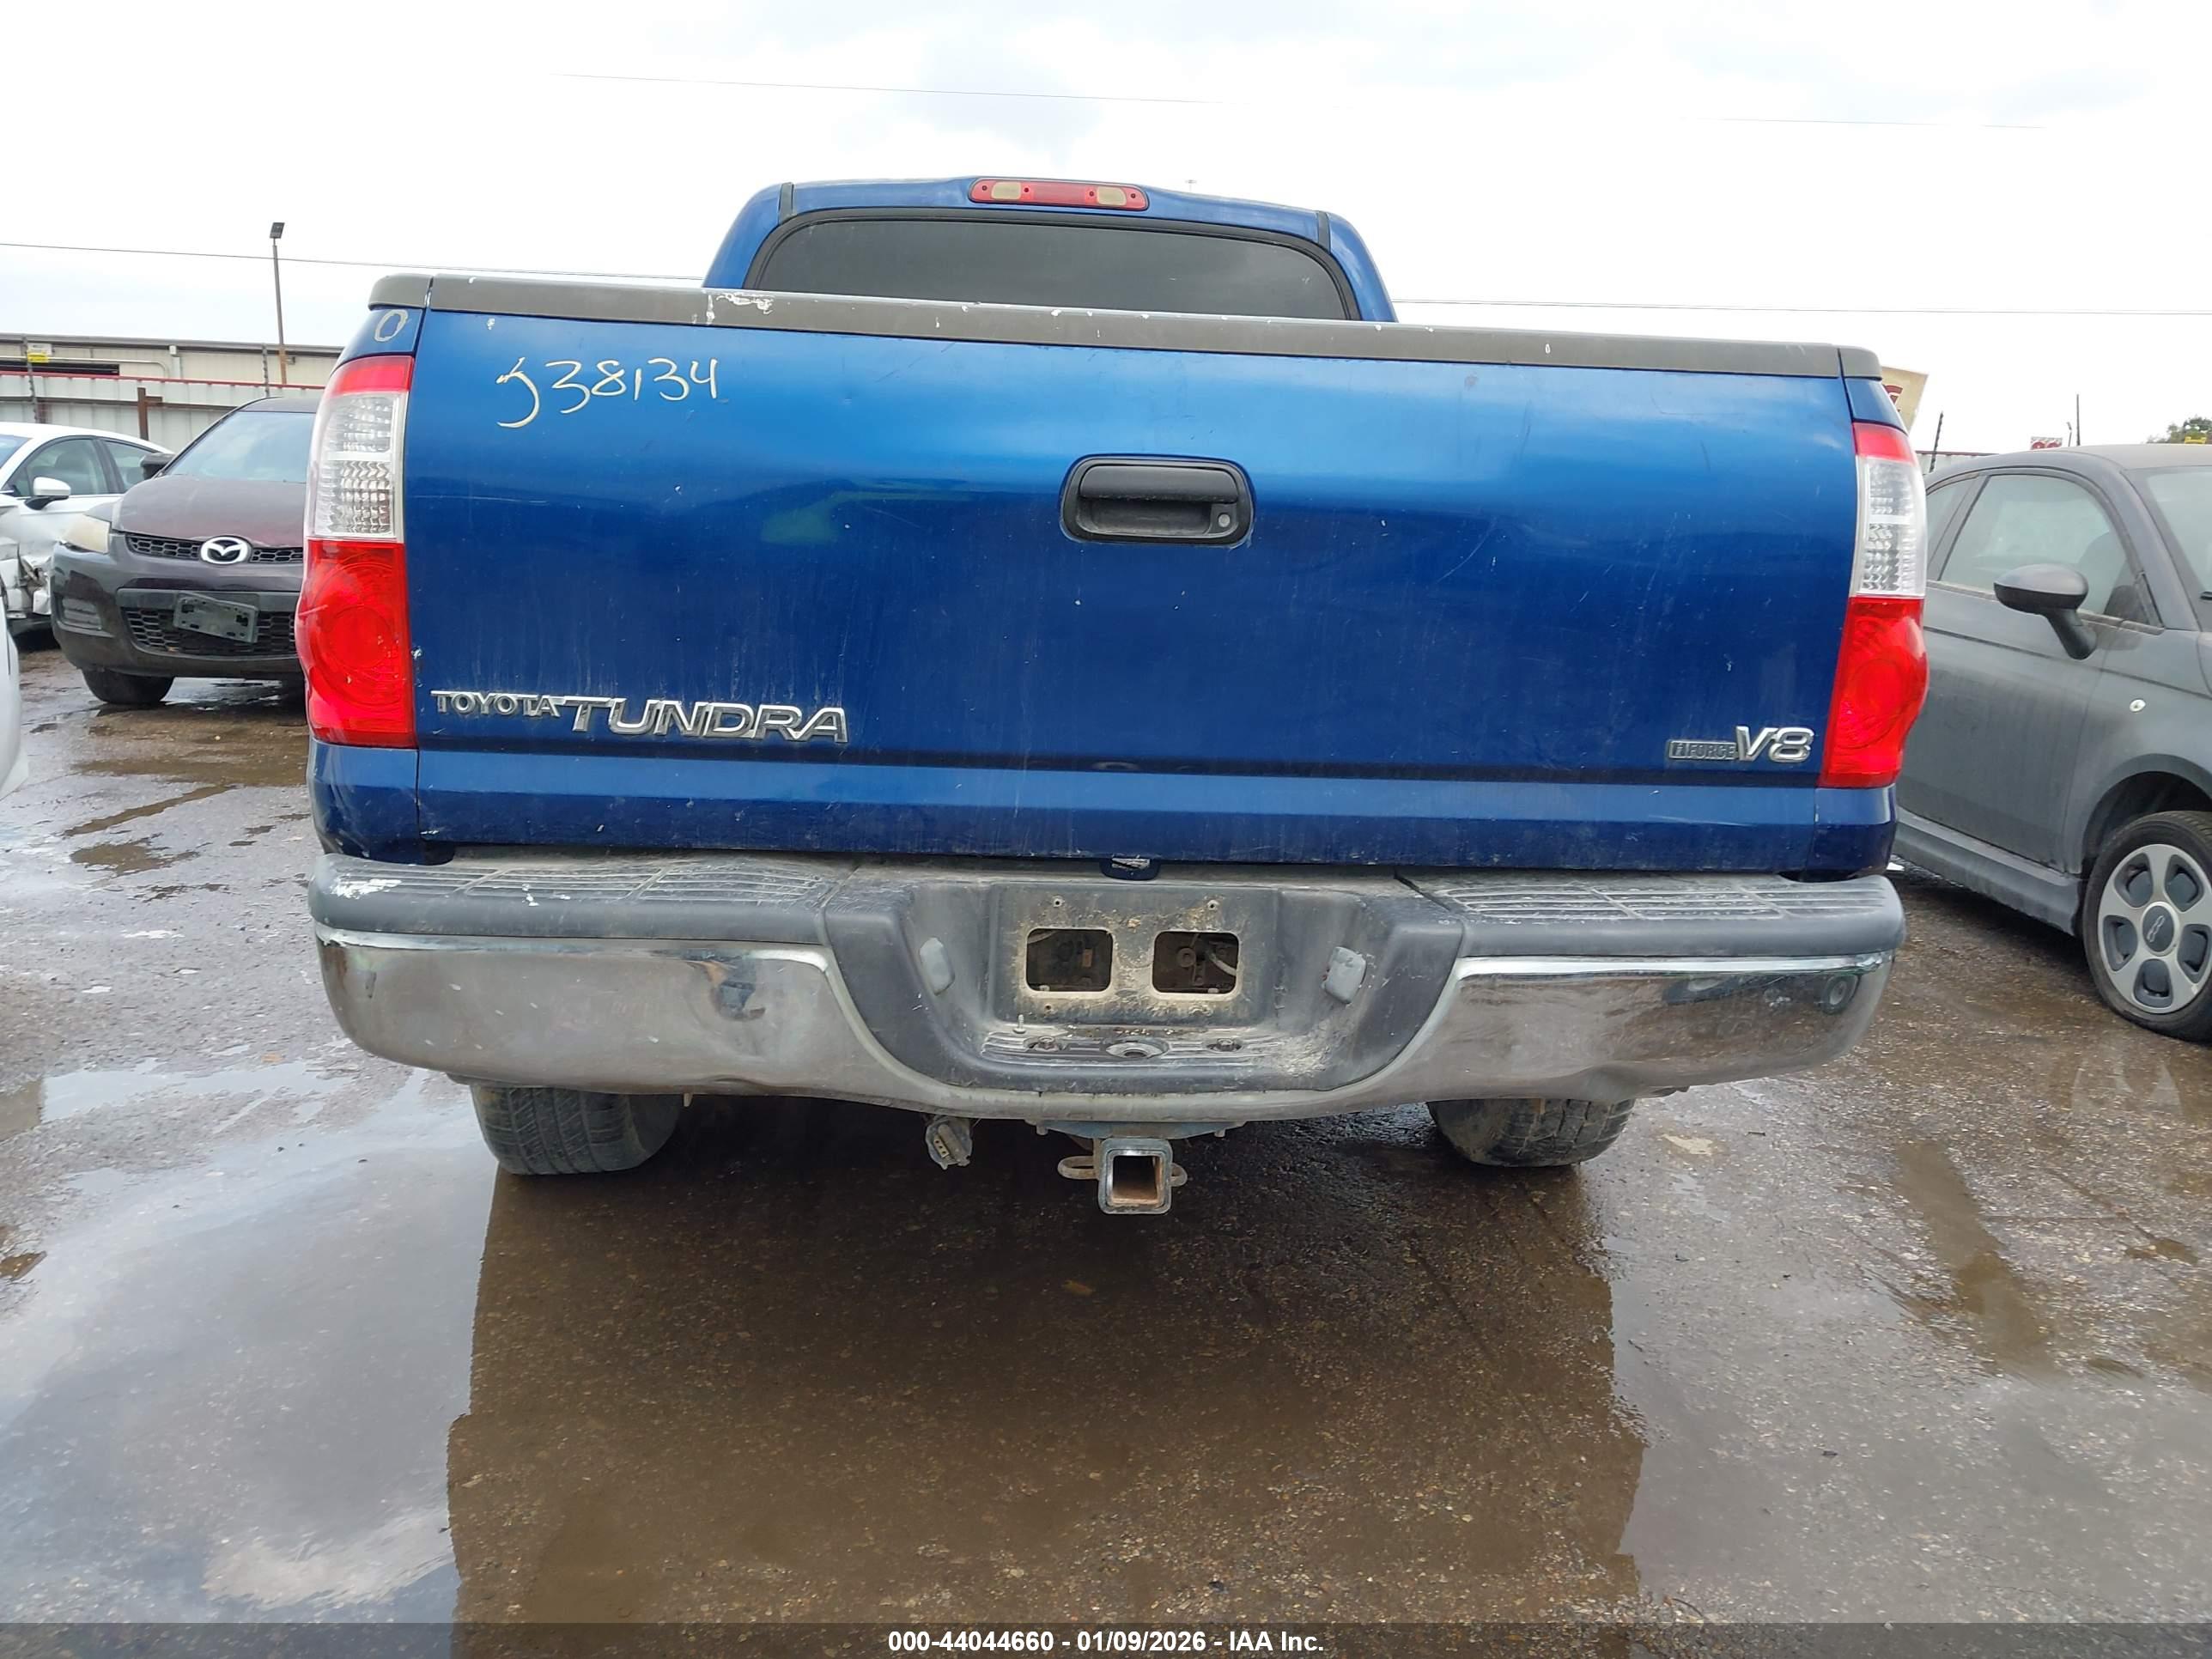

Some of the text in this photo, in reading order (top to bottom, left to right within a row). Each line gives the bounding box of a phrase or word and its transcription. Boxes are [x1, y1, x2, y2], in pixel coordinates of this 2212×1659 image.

[431, 690, 848, 743] TOYOTA TUNDRA
[1736, 726, 1815, 763] V8
